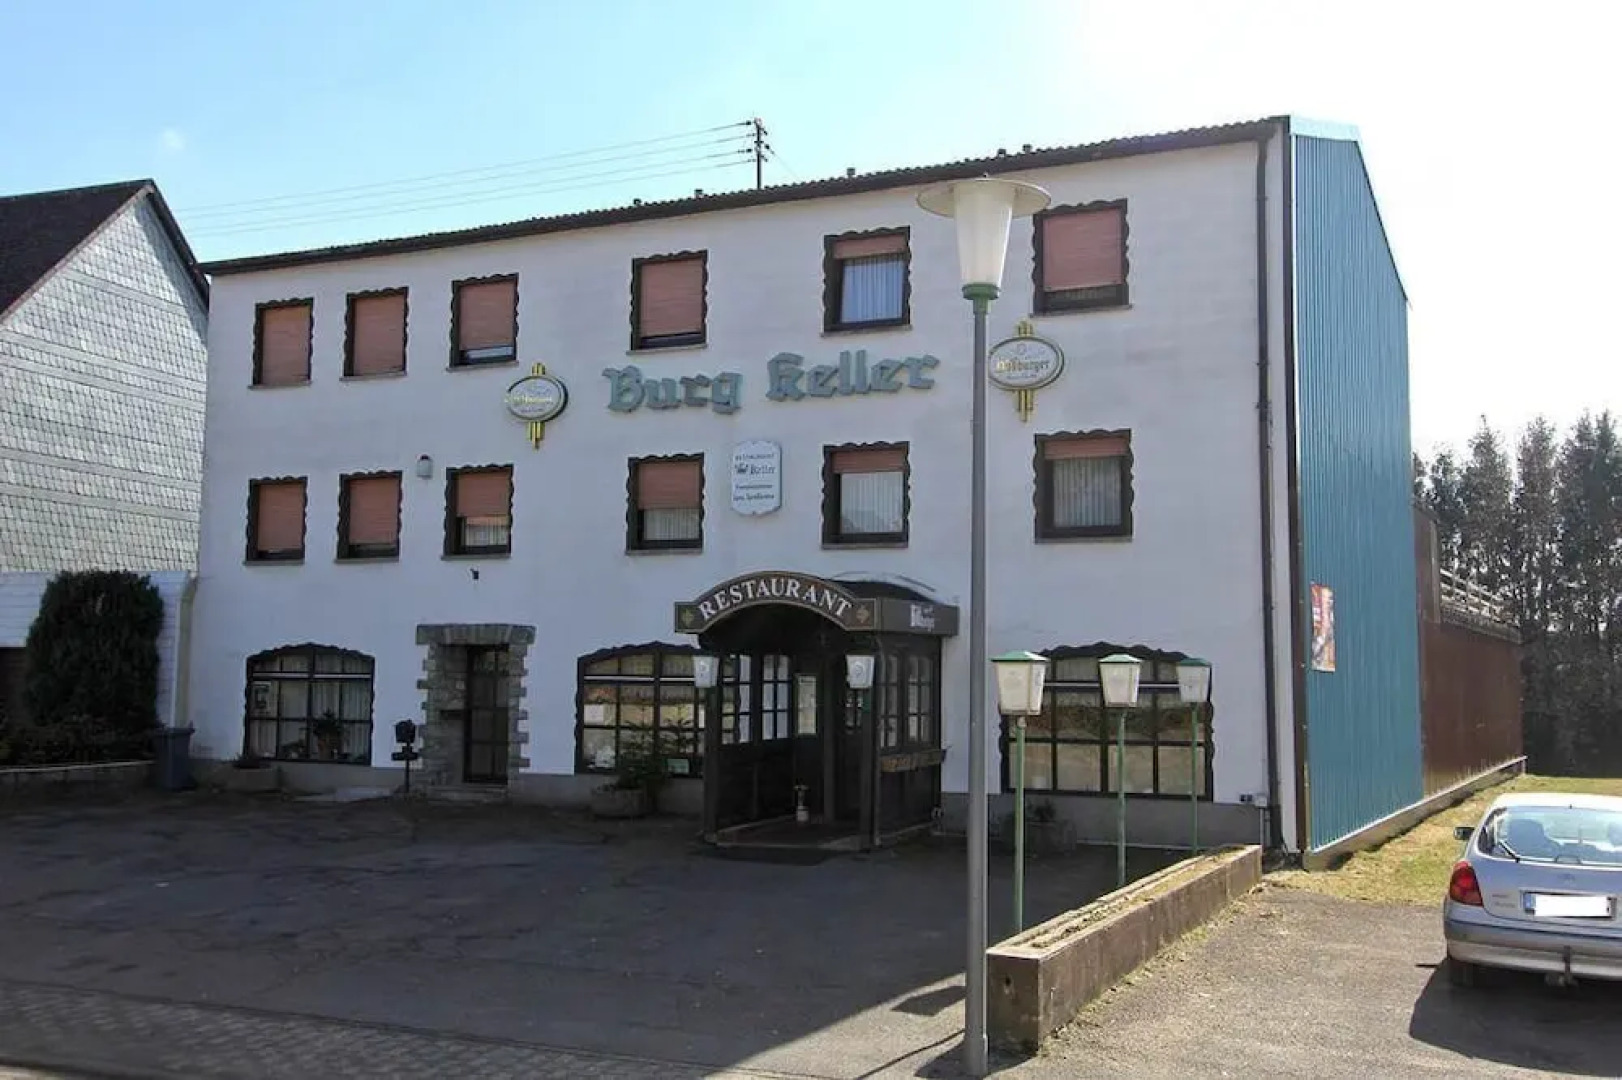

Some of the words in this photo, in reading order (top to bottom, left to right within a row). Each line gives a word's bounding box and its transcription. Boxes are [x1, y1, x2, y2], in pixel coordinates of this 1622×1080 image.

[601, 365, 743, 415] Burg
[766, 351, 940, 401] Keller
[698, 578, 853, 621] RESTAURANT
